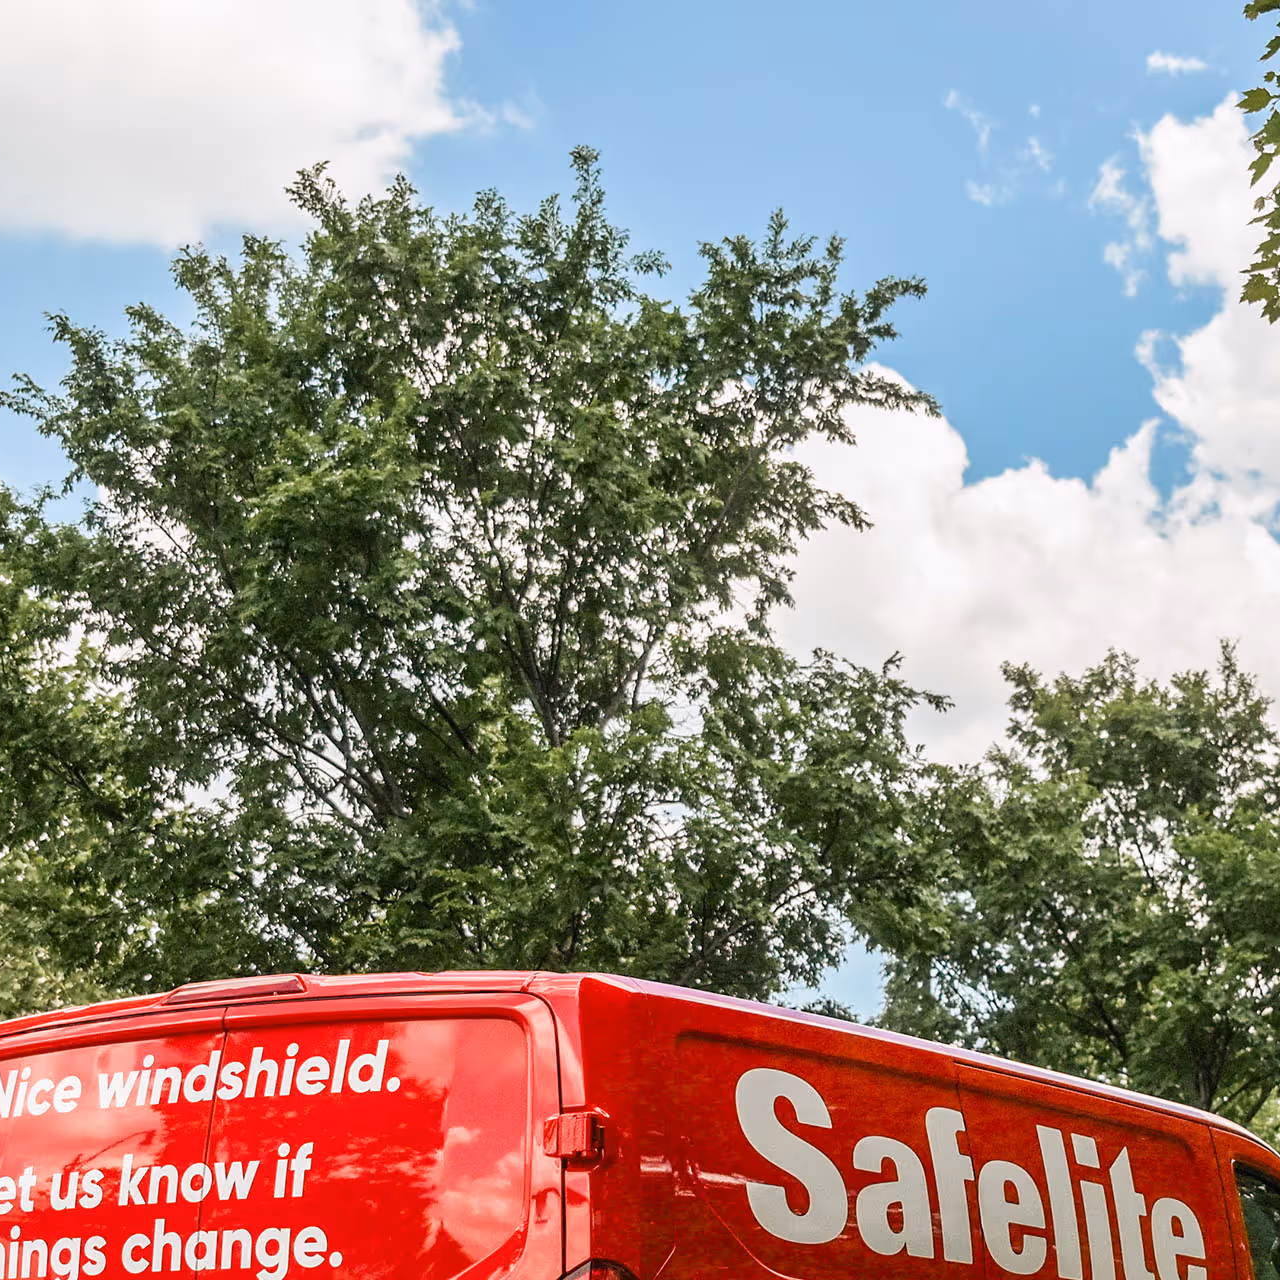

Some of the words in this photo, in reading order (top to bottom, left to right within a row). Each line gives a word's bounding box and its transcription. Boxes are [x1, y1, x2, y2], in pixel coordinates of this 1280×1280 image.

[99, 1039, 402, 1109] windshield.
[50, 1167, 104, 1210] us
[117, 1153, 259, 1207] know
[274, 1142, 314, 1199] if
